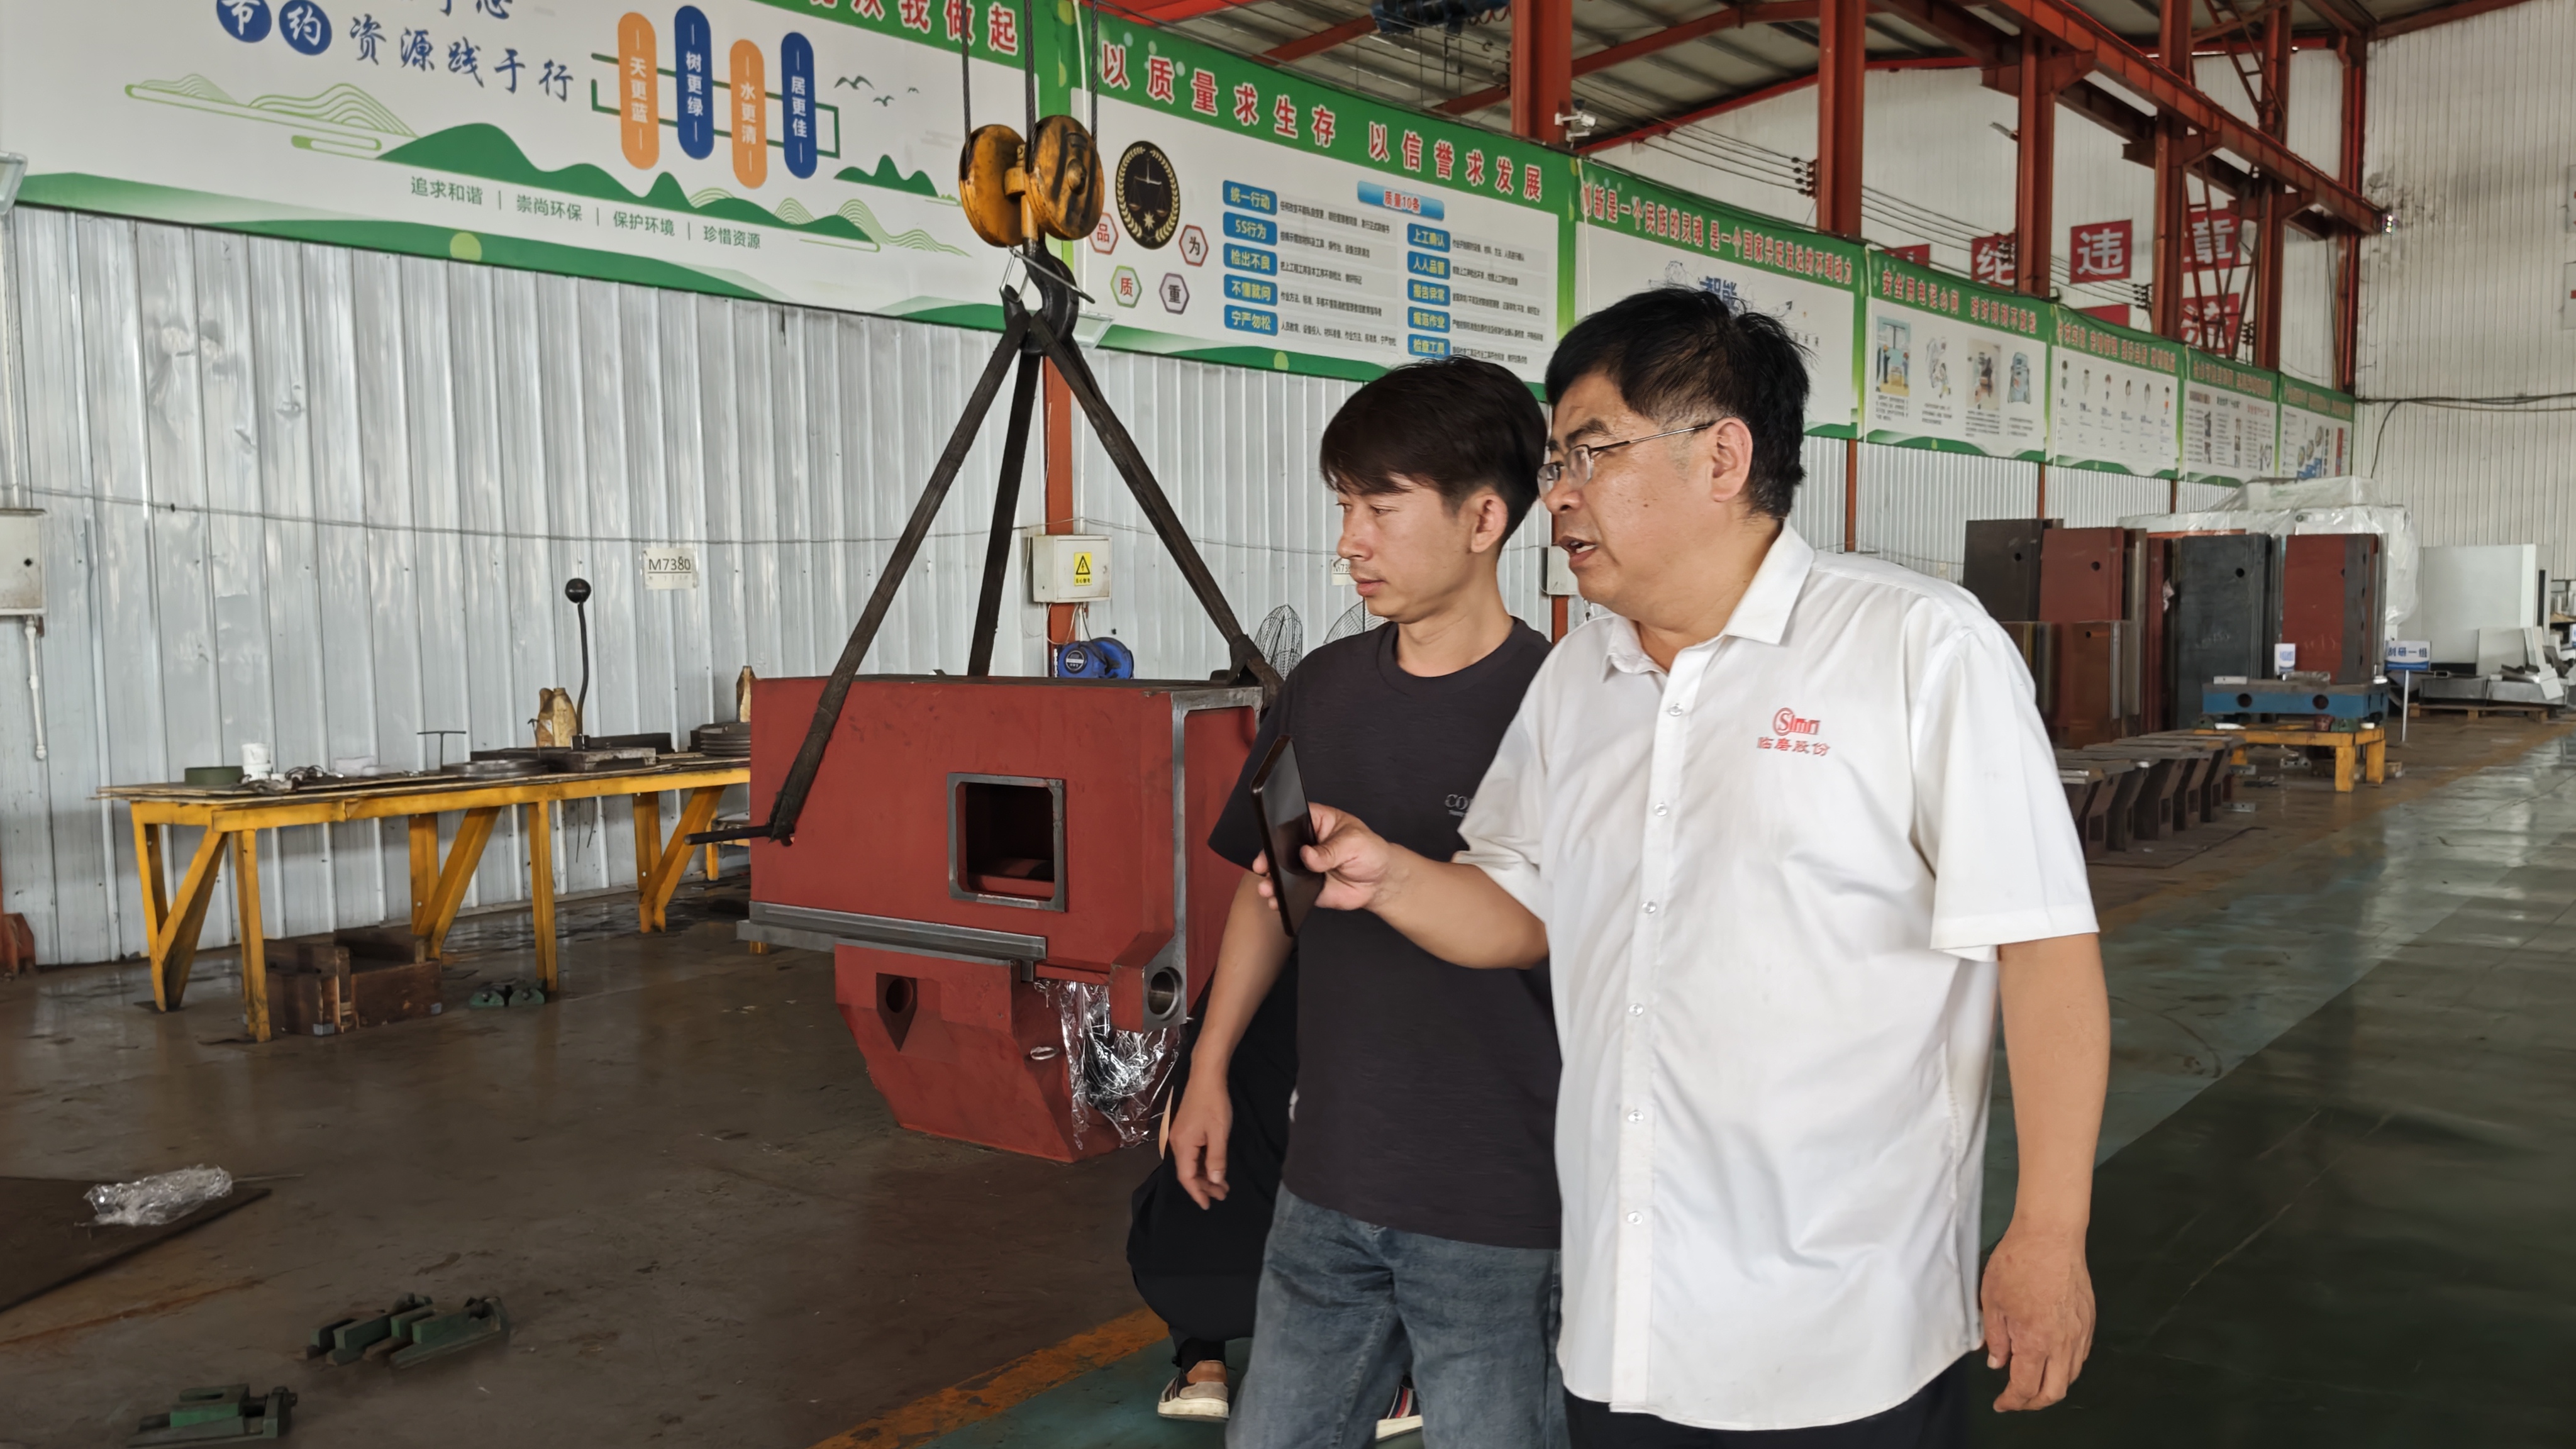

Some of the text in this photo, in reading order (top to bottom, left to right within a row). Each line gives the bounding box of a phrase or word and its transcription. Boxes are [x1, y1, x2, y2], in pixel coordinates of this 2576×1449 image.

[630, 57, 648, 123] 天更蓝
[686, 51, 703, 116] 树更绿
[740, 82, 757, 145] 水更清
[791, 76, 808, 138] 居更佳
[1102, 41, 1541, 202] 以质量求生存 以信誉求发展
[1230, 186, 1270, 210] 统一行动
[1384, 191, 1421, 213] 质量10条
[411, 176, 761, 250] 追求和谐 崇尚环保 保护环境 珍惜资源
[1097, 223, 1109, 243] 品
[1235, 219, 1267, 240] 5S行为
[1189, 236, 1201, 256] 为
[2077, 228, 2124, 275] 违
[1120, 277, 1133, 297] 质
[1168, 284, 1181, 304] 重
[1231, 280, 1271, 302] 不懂就问
[1231, 311, 1271, 331] 宁严勿松
[648, 557, 691, 570] M7380
